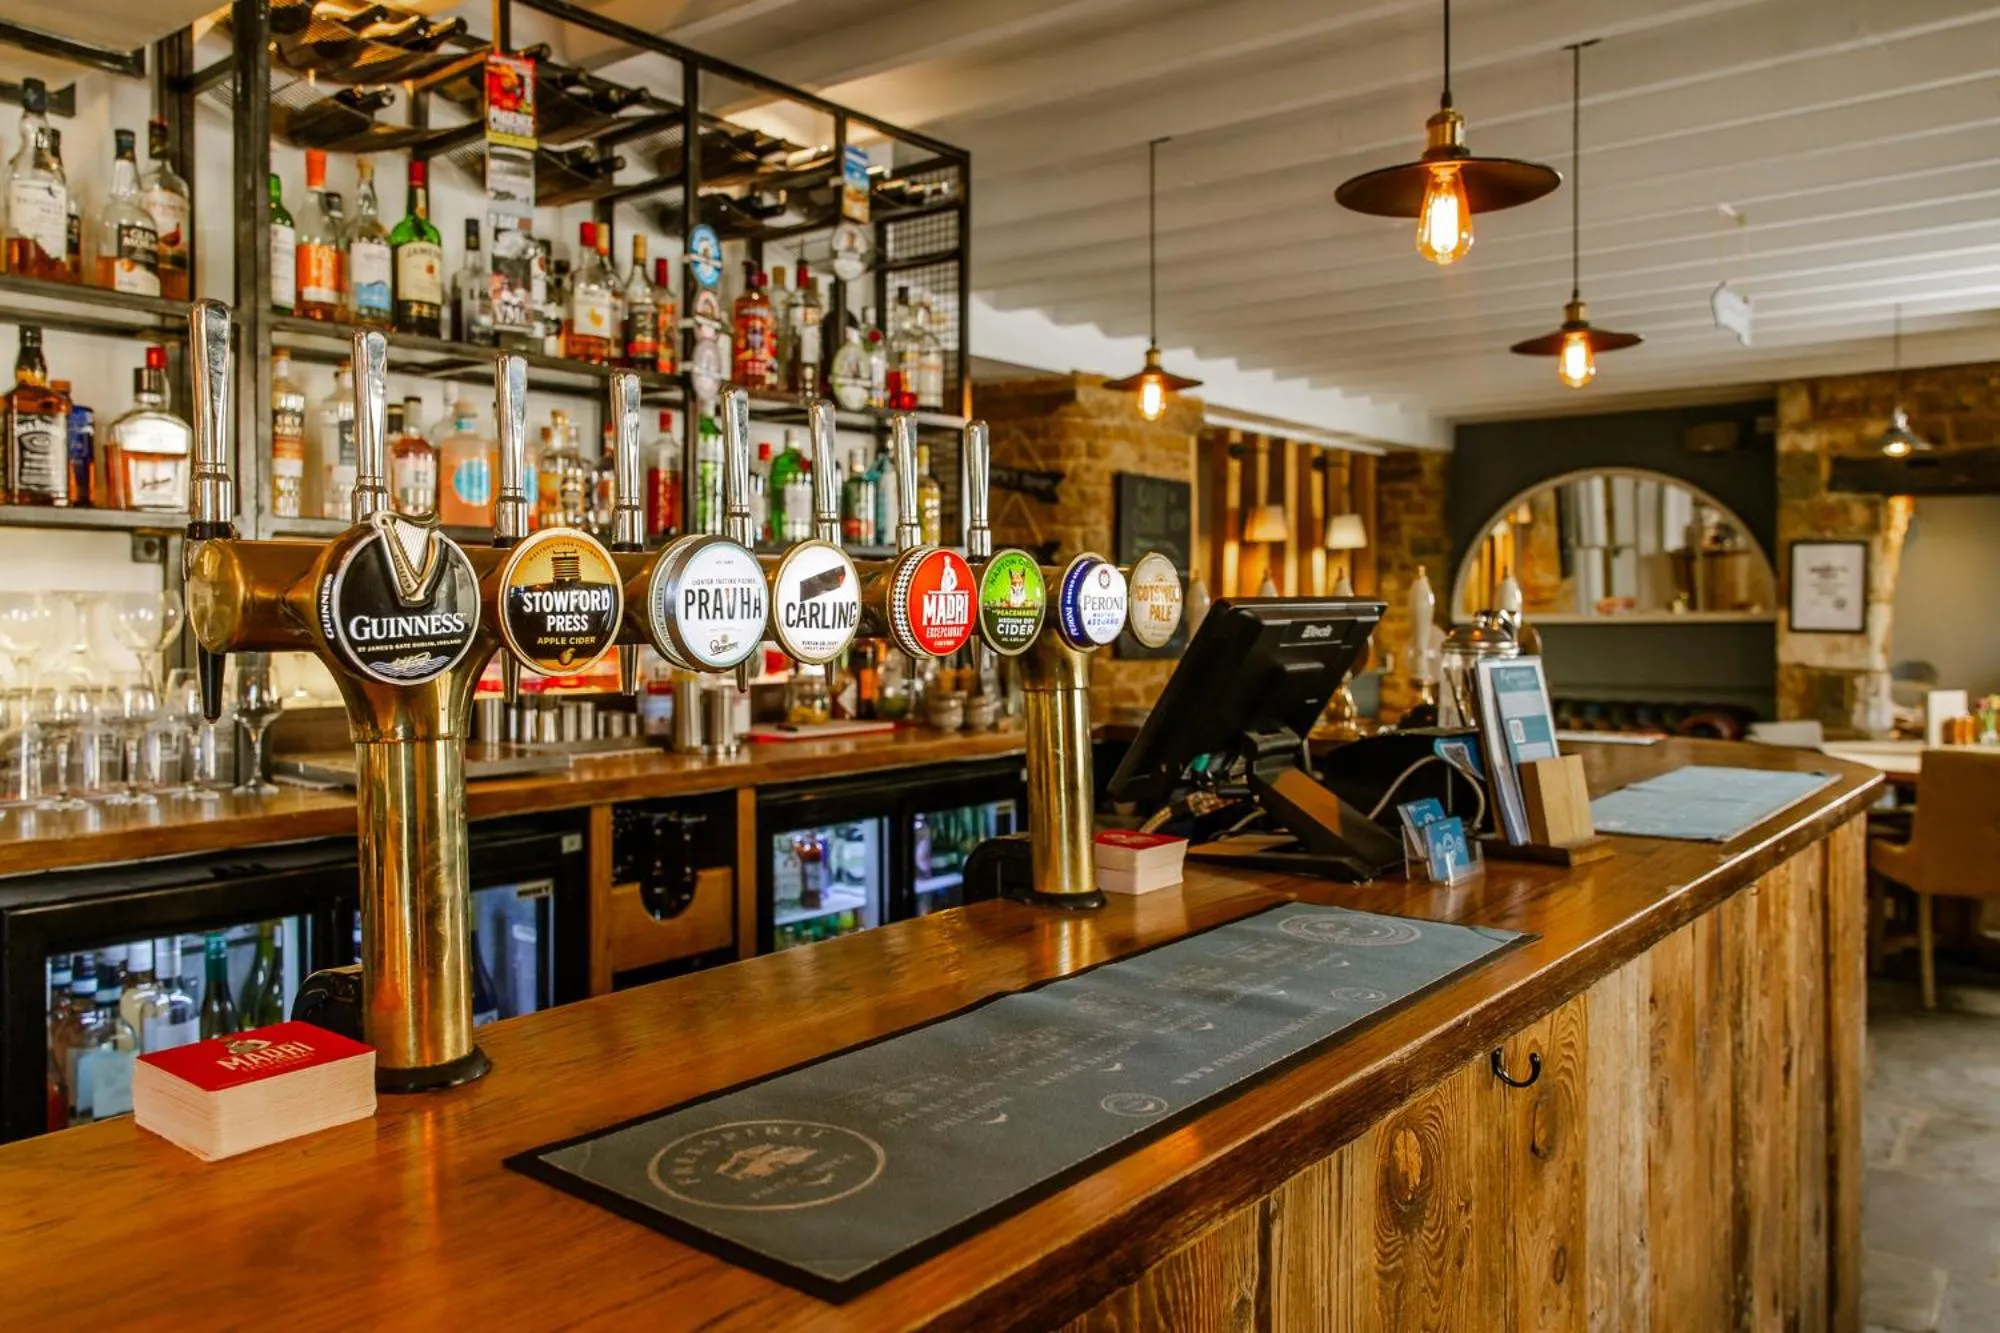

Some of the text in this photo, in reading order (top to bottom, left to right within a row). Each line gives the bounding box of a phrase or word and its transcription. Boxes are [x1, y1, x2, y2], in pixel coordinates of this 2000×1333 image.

[321, 573, 336, 640] GUINNESS
[522, 588, 611, 614] STOWFORD
[684, 587, 763, 620] PRAVHA
[1083, 595, 1125, 612] PERONI
[546, 614, 589, 632] PRESS
[785, 601, 858, 630] CARLING
[1149, 603, 1173, 622] PALE
[349, 612, 466, 641] GUINNESS
[995, 624, 1035, 636] CIDER
[536, 635, 597, 645] APPLE CIDER
